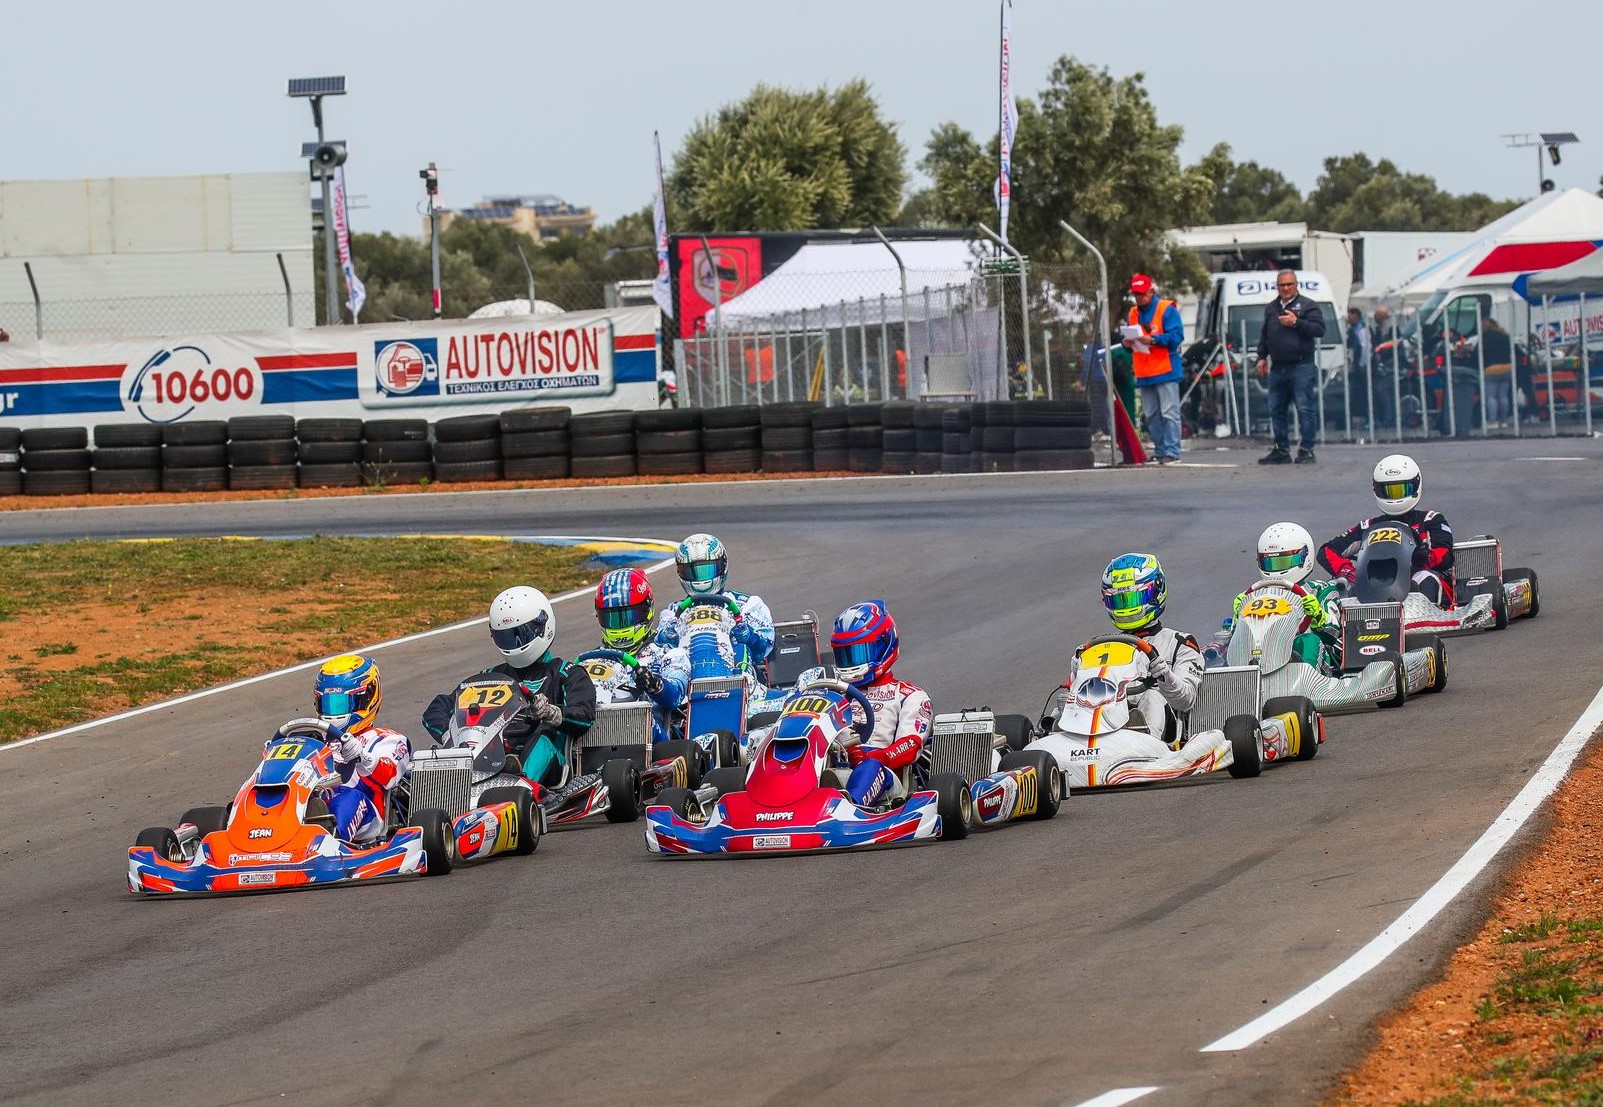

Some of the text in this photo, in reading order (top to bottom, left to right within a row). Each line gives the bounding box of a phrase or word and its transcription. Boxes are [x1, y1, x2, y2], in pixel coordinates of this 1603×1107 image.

[446, 327, 599, 379] AUTOVISION
[151, 367, 254, 404] 10600
[1369, 530, 1401, 544] 222
[1251, 599, 1278, 611] 93
[1098, 653, 1109, 665] 1
[477, 689, 506, 706] 12
[867, 689, 896, 700] OVISION
[788, 697, 828, 714] 100
[270, 745, 299, 759] 14
[1070, 748, 1101, 757] KART
[1018, 773, 1037, 812] 100
[755, 811, 794, 822] PHILIPPE
[248, 828, 273, 839] JEAN
[505, 808, 517, 847] 14
